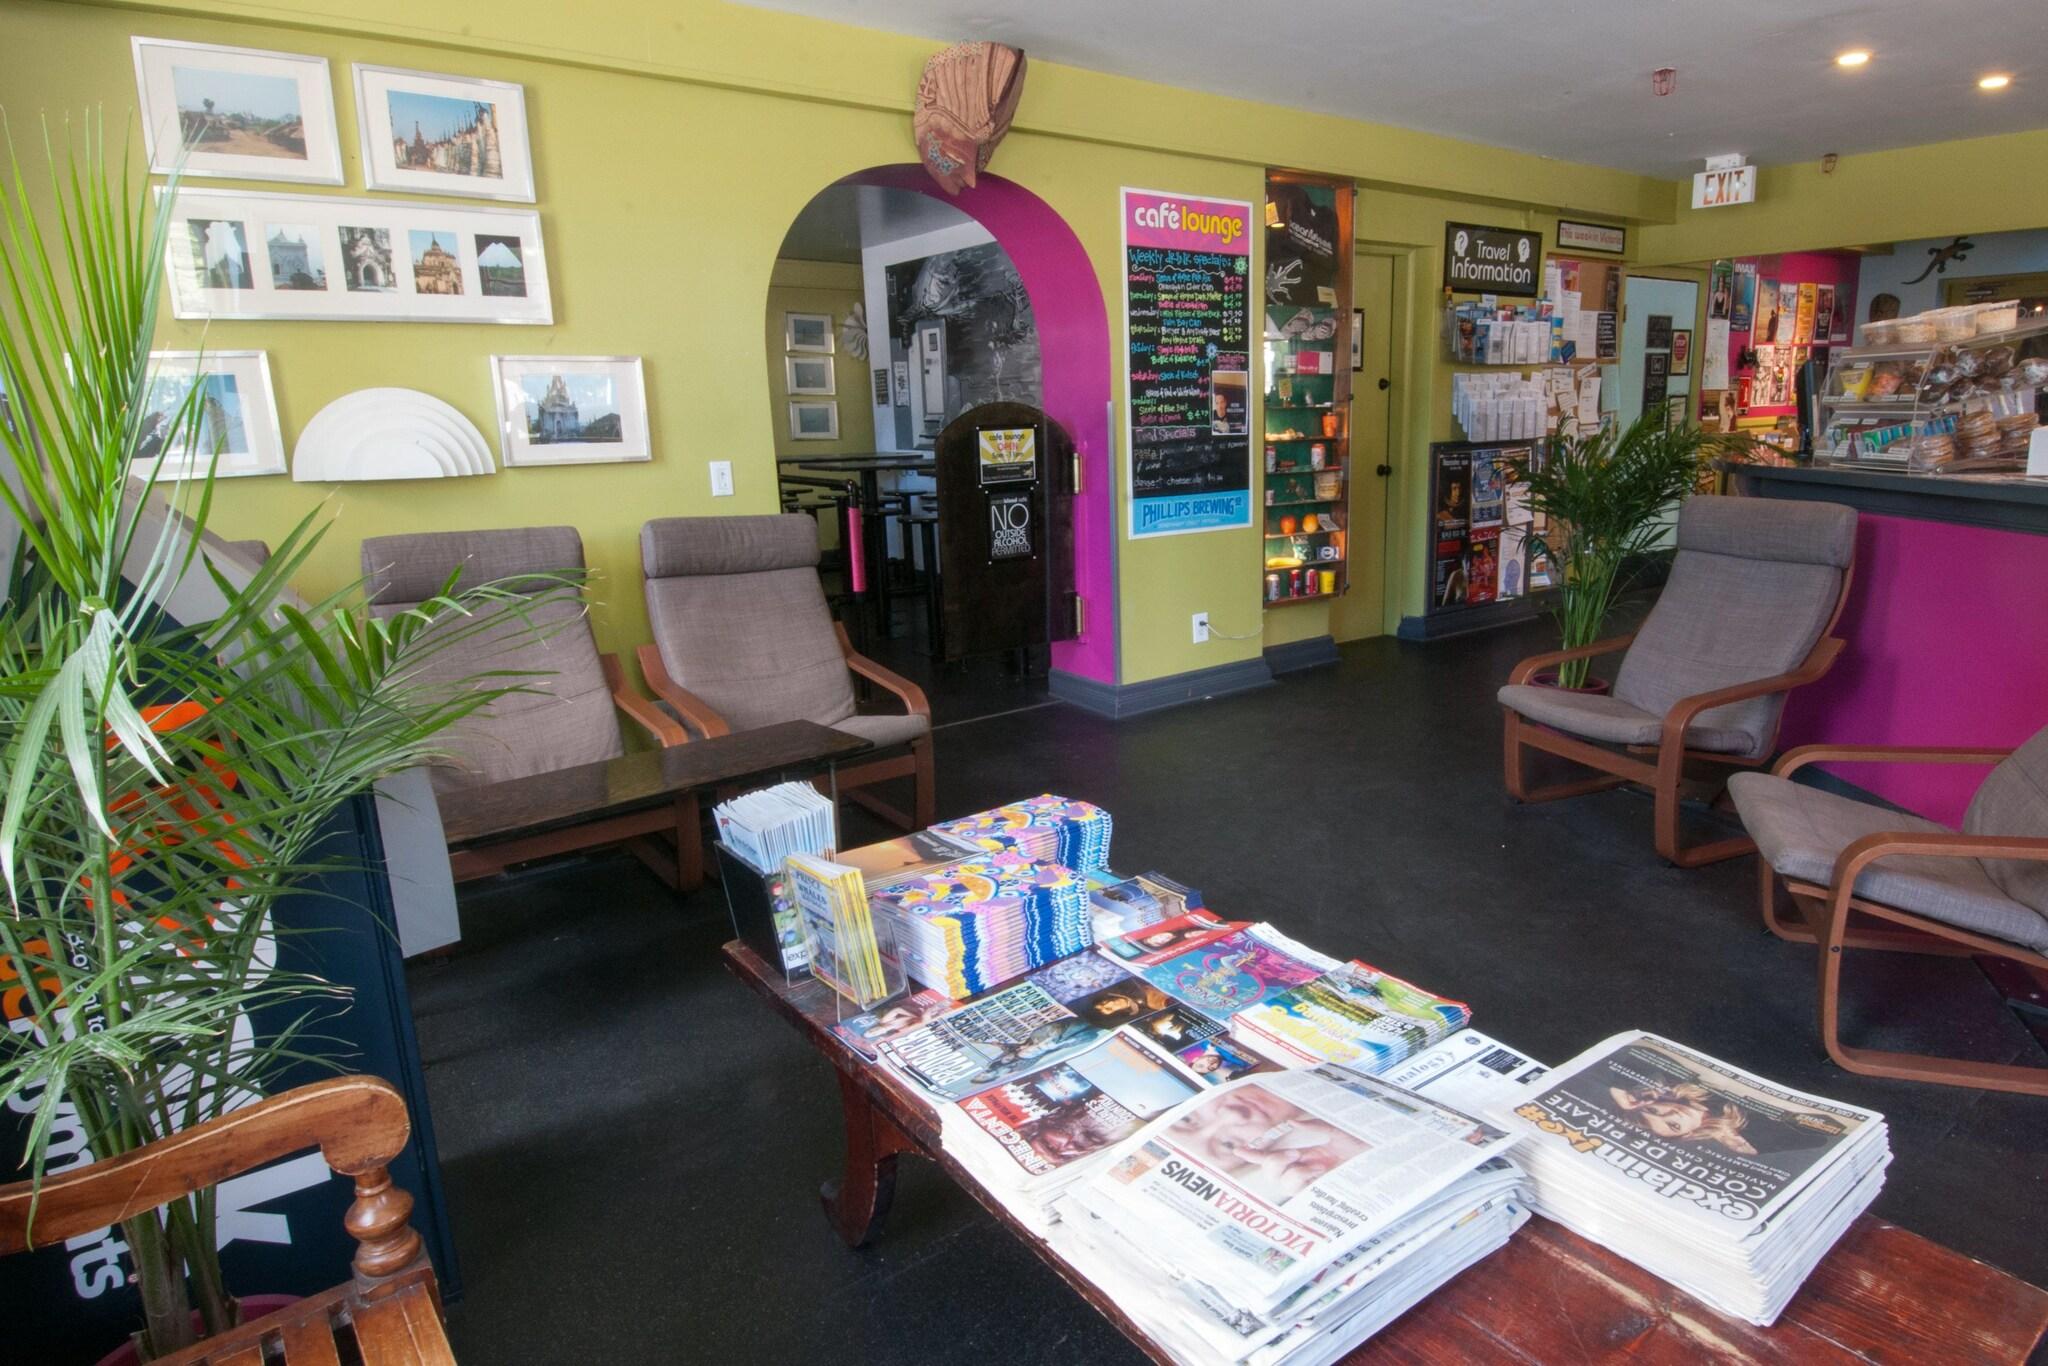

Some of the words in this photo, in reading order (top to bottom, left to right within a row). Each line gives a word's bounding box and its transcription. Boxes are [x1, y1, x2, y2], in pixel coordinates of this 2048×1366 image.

[1703, 170, 1744, 205] EXIT
[1135, 202, 1180, 229] café
[1182, 206, 1243, 244] lounge
[1129, 249, 1162, 269] Weekly
[1477, 240, 1511, 261] Travel
[1451, 255, 1531, 284] Information
[1160, 428, 1196, 441] Specials
[991, 503, 1029, 531] NO
[1143, 502, 1190, 527] PHILLIPS
[1193, 498, 1234, 515] BREWING
[993, 536, 1028, 549] ALCOHOL
[994, 528, 1026, 539] OUTSIDE
[991, 544, 1031, 556] PERMITTED
[1545, 1094, 1626, 1140] PIRATE
[1608, 1114, 1651, 1138] WATERS
[965, 1097, 1057, 1175] CINECENTA
[1630, 1138, 1668, 1160] DE
[1654, 1139, 1703, 1162] CHOPPY
[1161, 1160, 1221, 1202] NEWS
[1671, 1156, 1767, 1199] COEUR
[1707, 1162, 1777, 1190] NAVIGATES
[1214, 1191, 1316, 1257] VICTORIA
